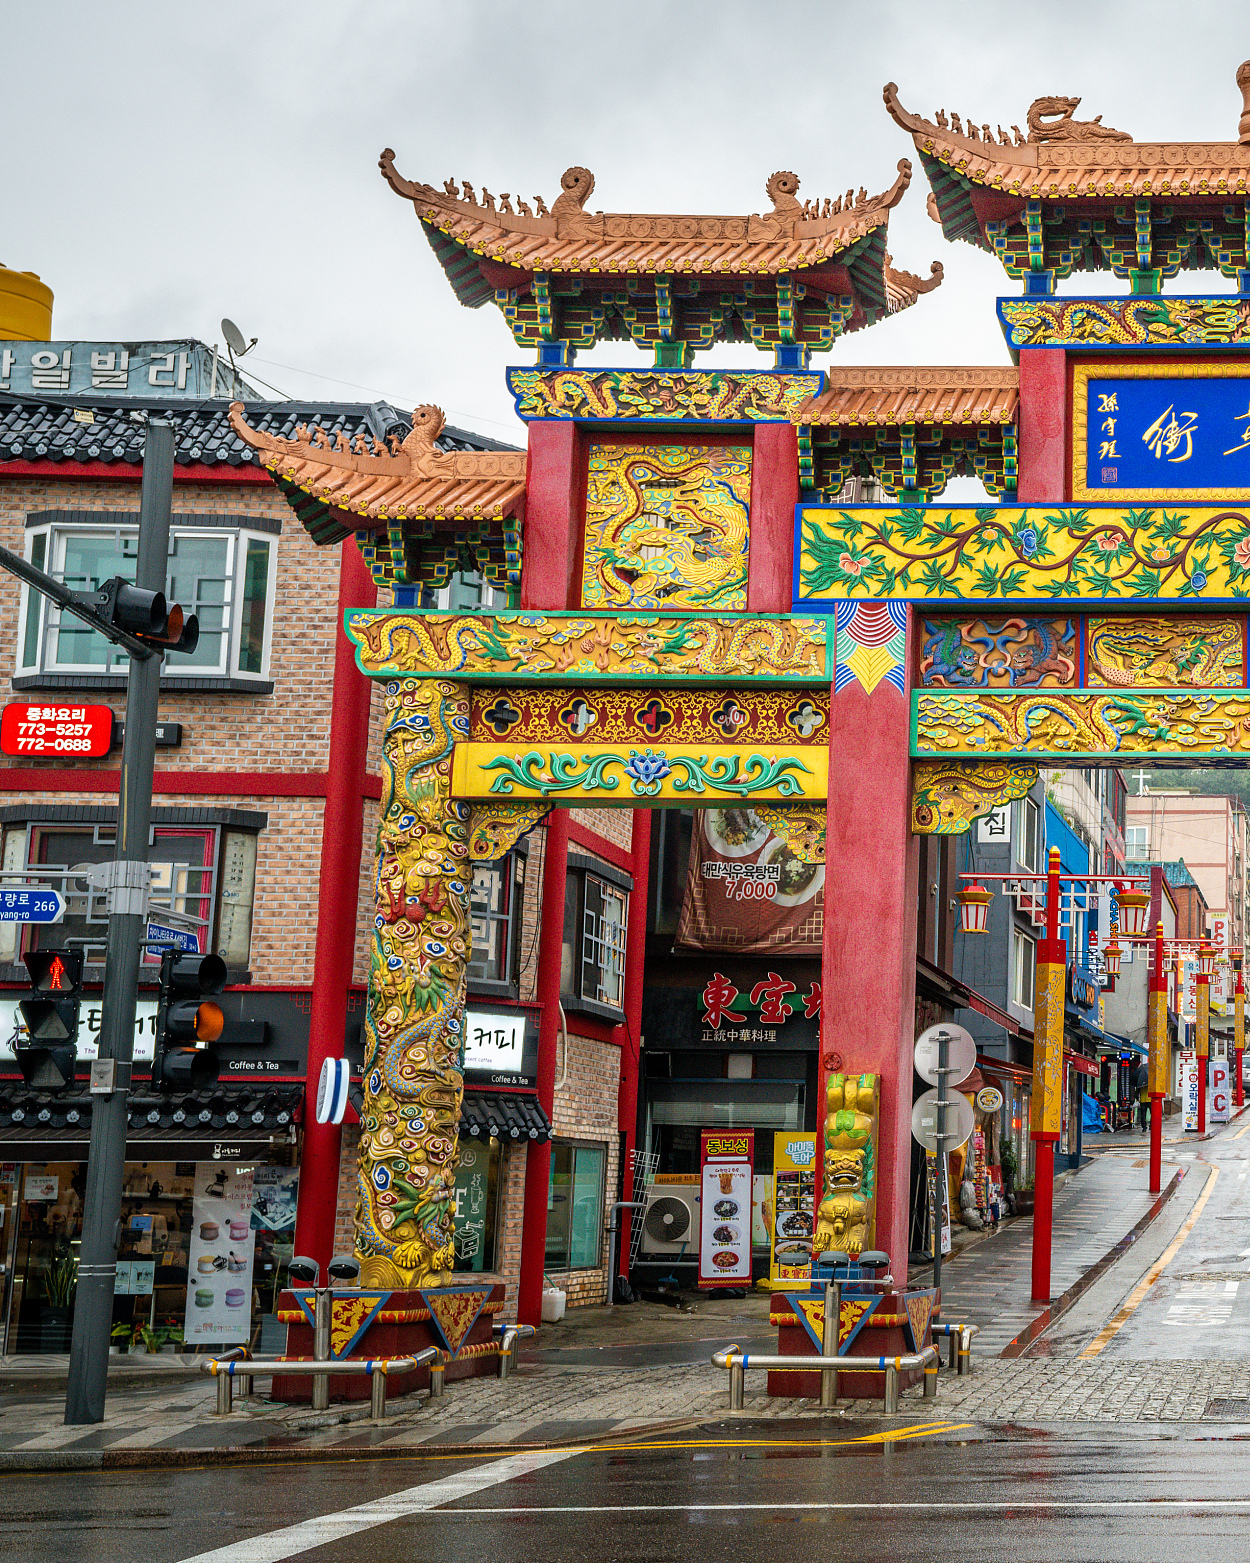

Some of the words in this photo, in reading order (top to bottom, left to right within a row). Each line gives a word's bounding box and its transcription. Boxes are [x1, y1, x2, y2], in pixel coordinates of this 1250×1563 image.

[26, 707, 86, 721] 중화요리
[17, 723, 93, 736] 773-5257
[17, 738, 92, 751] 772-0688
[702, 861, 781, 880] 대만식우육탕면
[726, 880, 778, 900] 7,000
[33, 901, 56, 912] 266
[701, 1029, 777, 1042] 正統中華料理
[229, 1061, 256, 1070] Coffee
[257, 1061, 264, 1070] &
[265, 1061, 279, 1070] Tea
[491, 1074, 511, 1083] Coffee
[512, 1075, 517, 1084] &
[518, 1077, 529, 1085] Tea
[706, 1138, 749, 1154] 동보성
